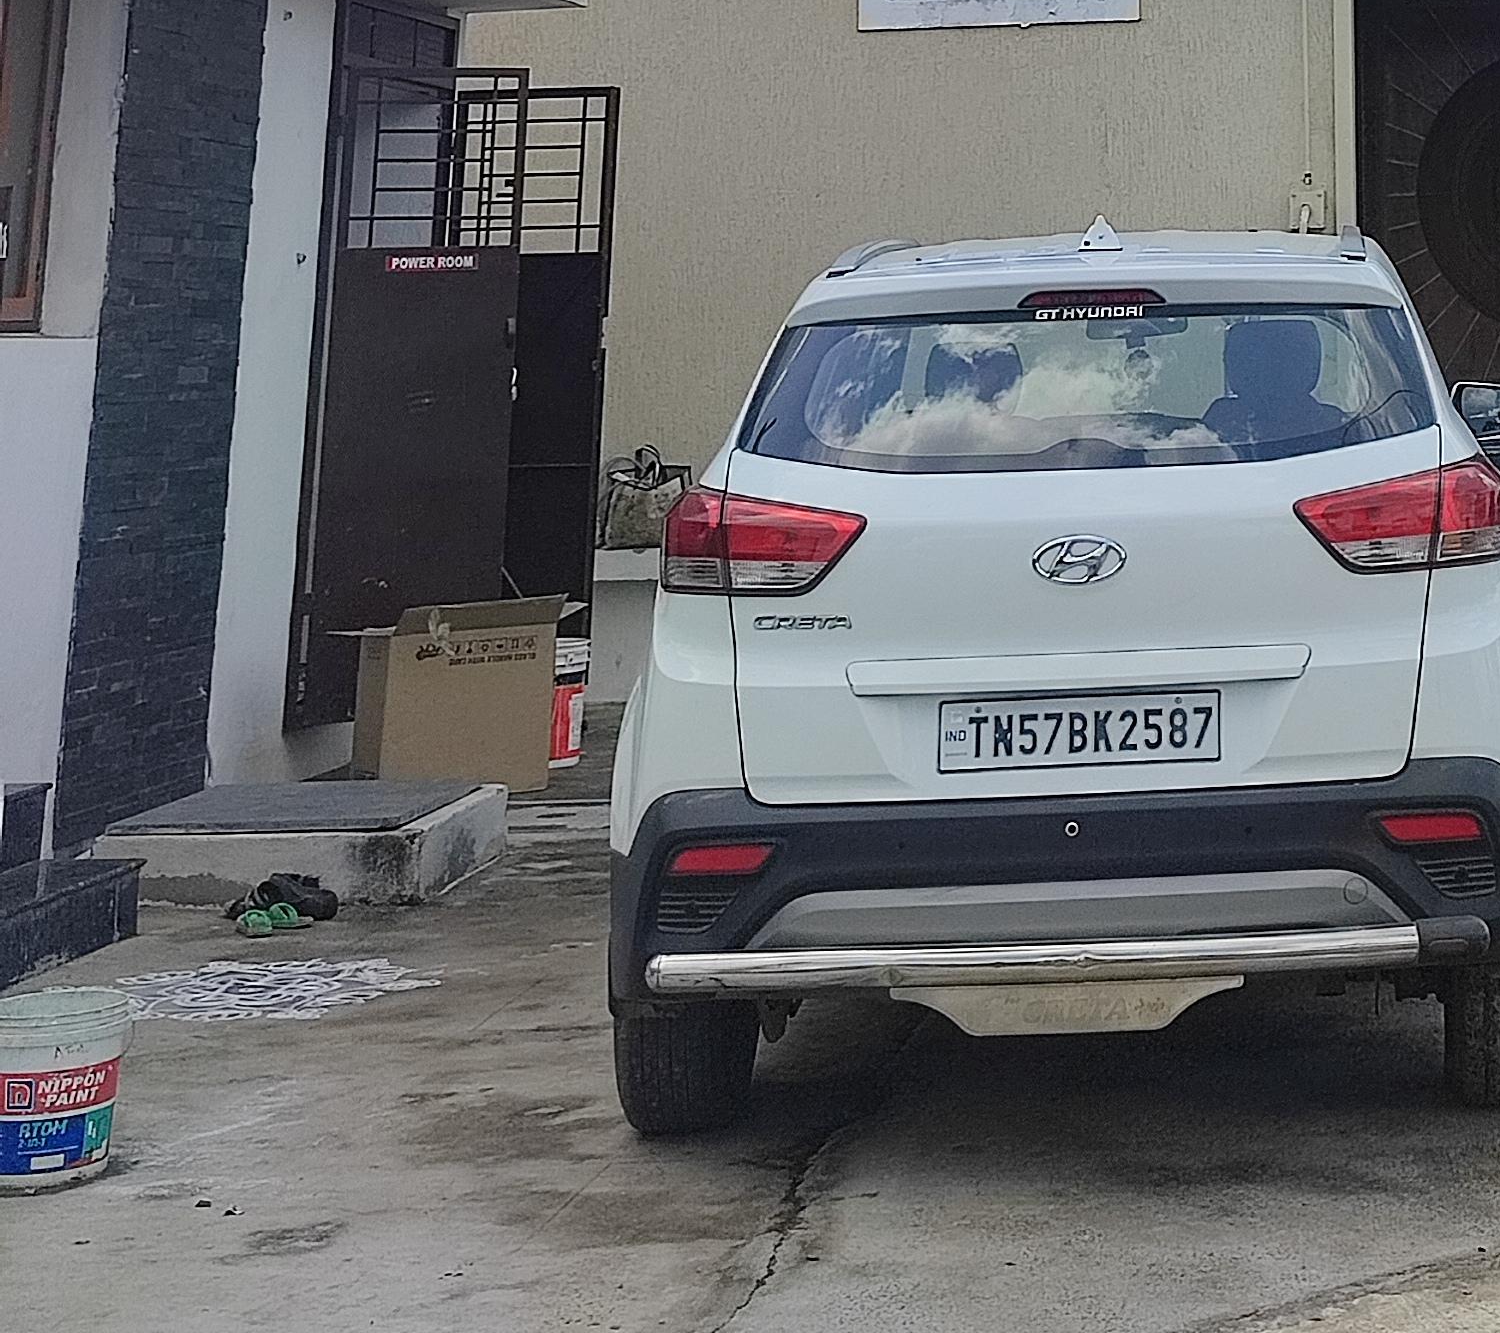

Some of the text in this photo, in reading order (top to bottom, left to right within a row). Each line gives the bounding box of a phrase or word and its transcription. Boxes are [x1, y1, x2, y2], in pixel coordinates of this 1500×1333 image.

[391, 255, 474, 270] POWER ROOM
[1034, 305, 1143, 320] GT HYUNDAI
[753, 615, 852, 631] CRETA
[945, 730, 967, 742] IND
[968, 706, 1213, 758] TN57BK2587
[37, 1070, 106, 1094] NIPPON
[44, 1086, 99, 1108] PAINT
